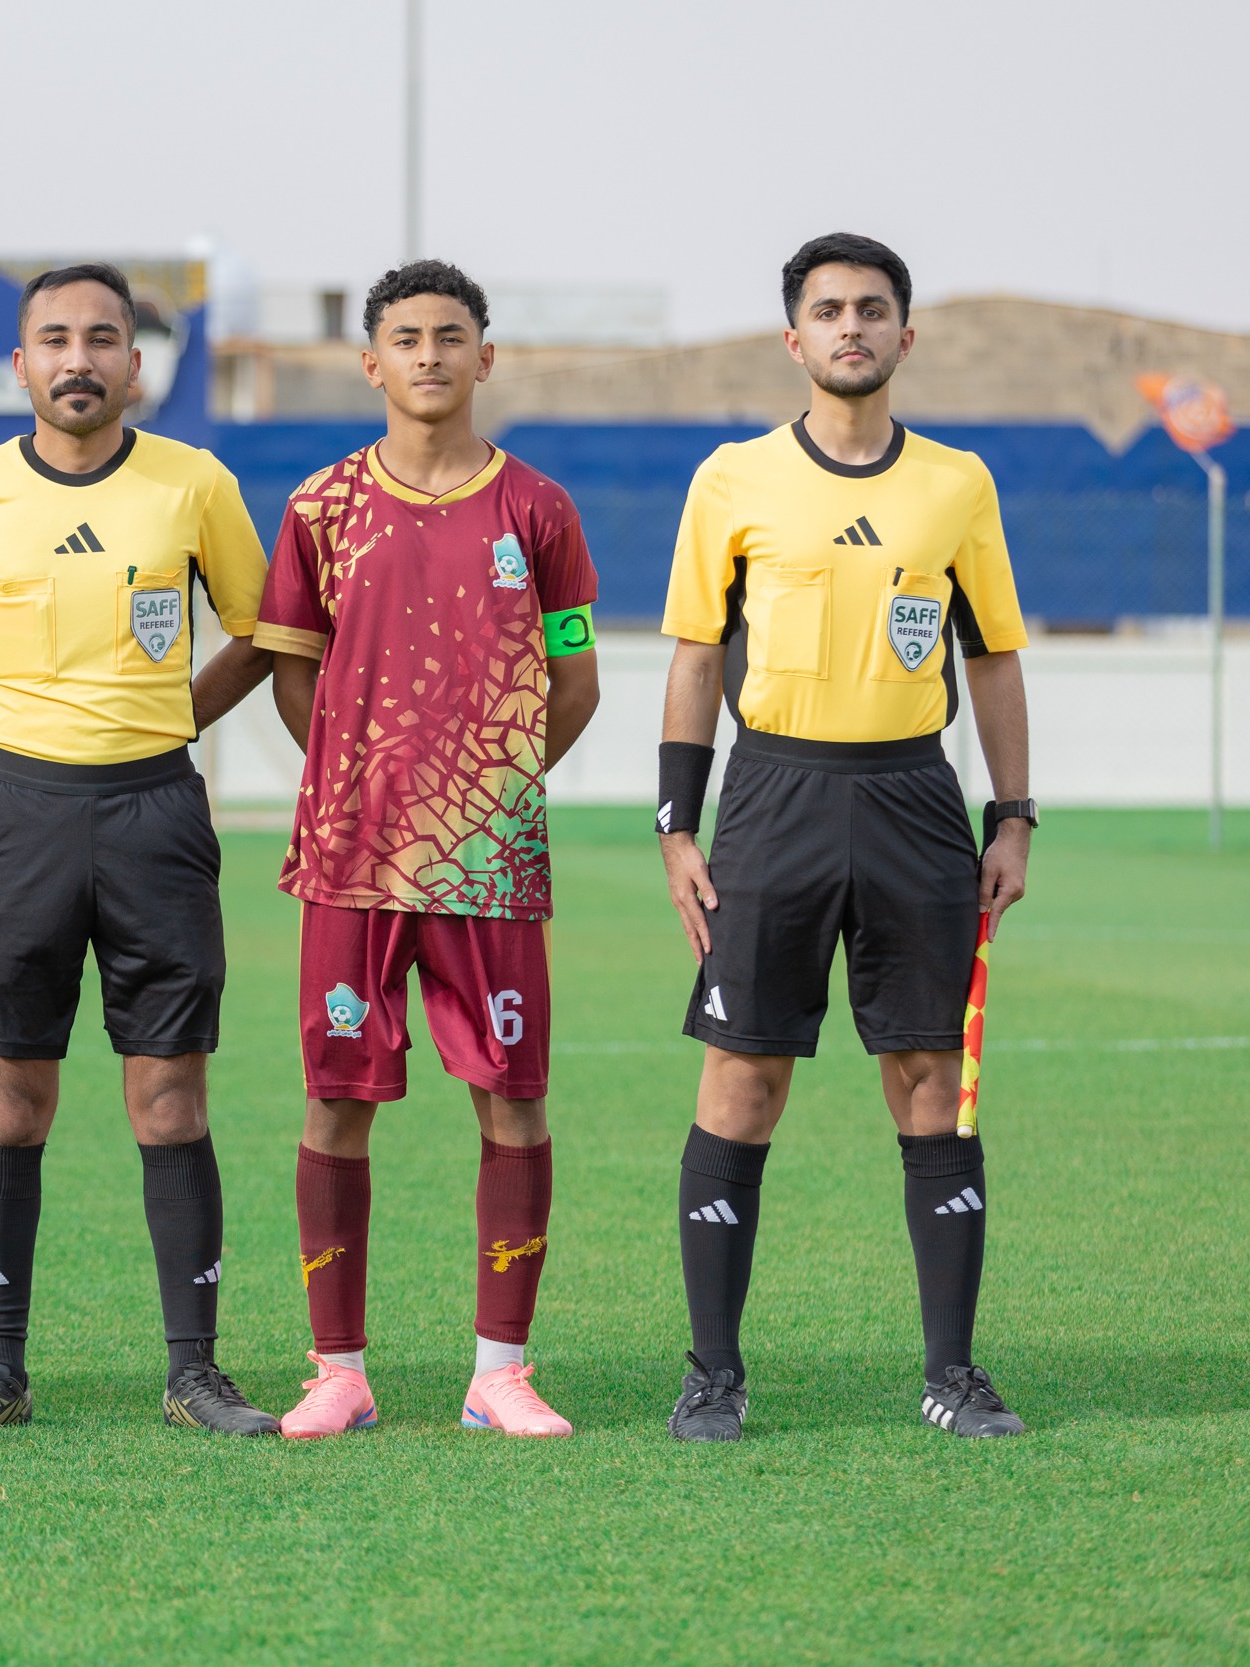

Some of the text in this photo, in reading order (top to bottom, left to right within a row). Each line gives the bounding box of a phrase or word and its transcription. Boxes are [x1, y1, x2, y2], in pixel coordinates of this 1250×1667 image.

[135, 598, 177, 618] SAFF
[894, 605, 937, 625] SAFF
[139, 620, 174, 629] REFEREE
[897, 627, 932, 638] REFEREE
[487, 989, 524, 1046] 6
